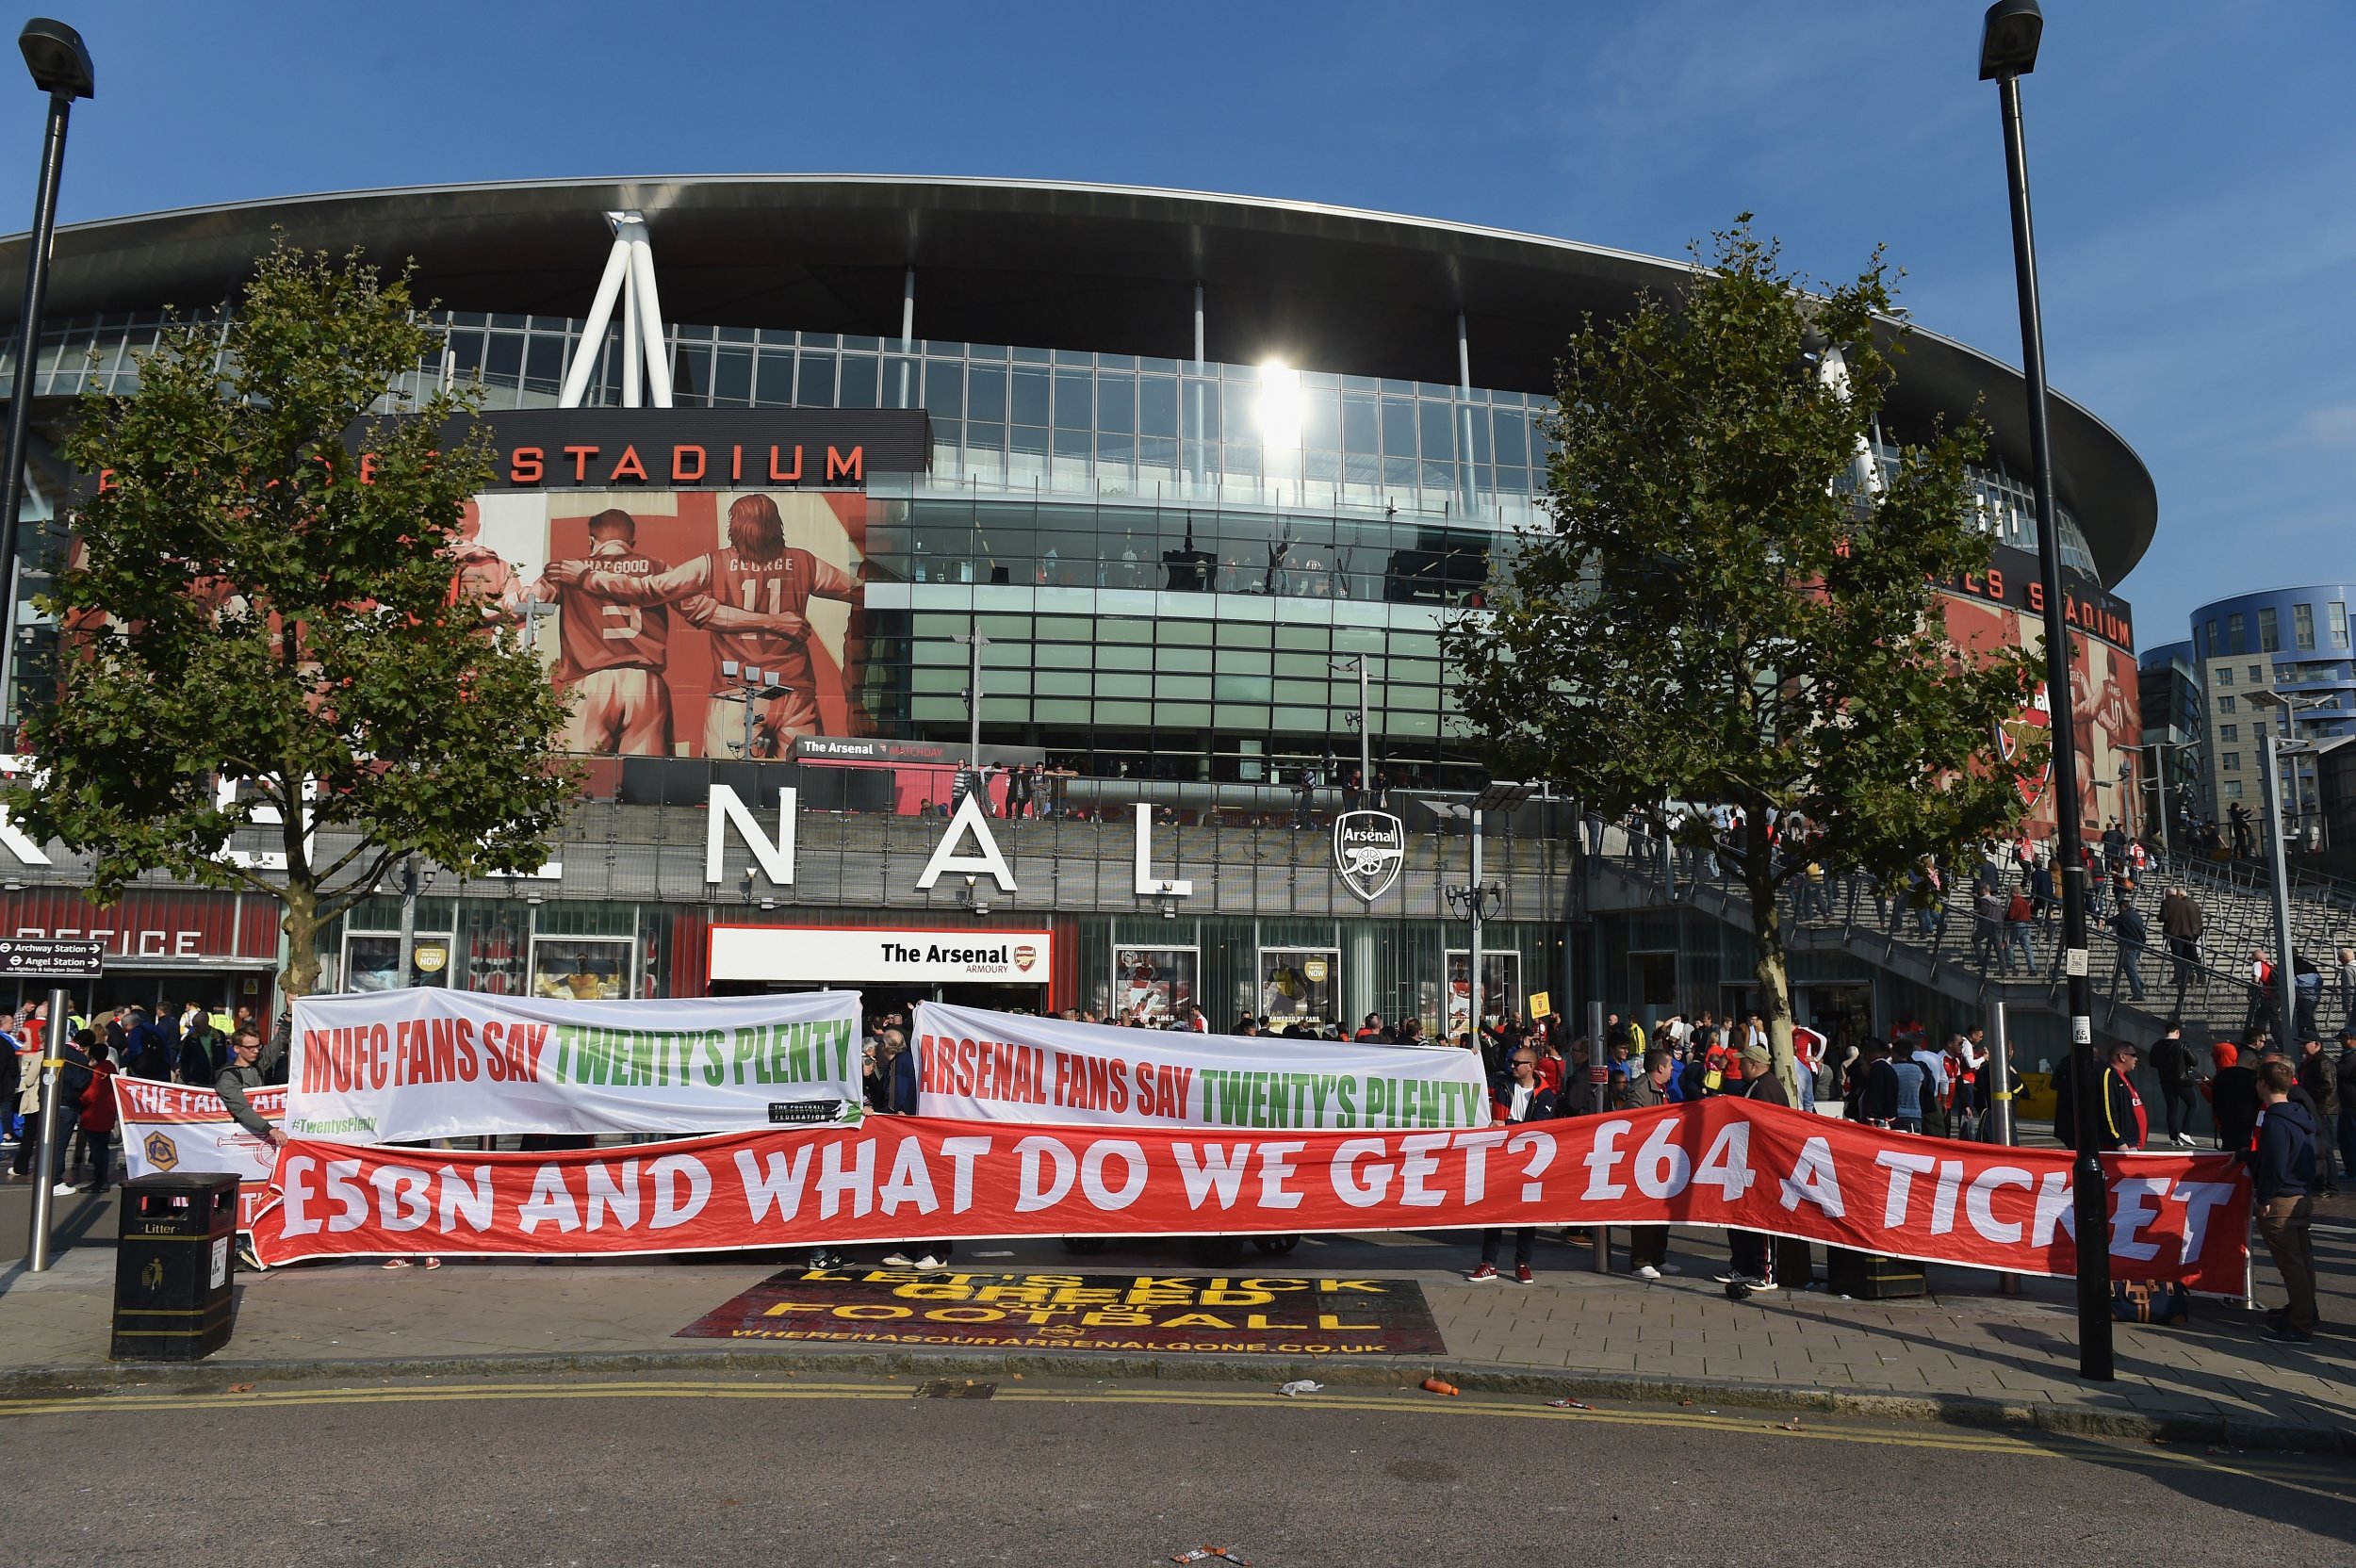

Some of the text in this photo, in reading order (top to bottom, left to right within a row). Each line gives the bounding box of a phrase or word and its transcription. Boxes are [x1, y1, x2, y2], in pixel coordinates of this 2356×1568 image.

[510, 444, 862, 484] STADIUM
[2029, 581, 2131, 647] SADIUM
[804, 741, 943, 759] The Arsenal MATCHDAY
[1344, 827, 1396, 842] Arsenal
[14, 943, 87, 955] Archway Station
[881, 943, 1008, 964] The Arsenal
[25, 956, 86, 967] Angel Station
[419, 956, 442, 966] NOW
[965, 964, 1008, 973] ARMOURY
[301, 1018, 853, 1093] MUFC FANS SAY TWENTY'S PLENTY
[919, 1034, 1481, 1129] ARSENAL FANS SAY TWENTY'S PLENTY
[125, 1085, 173, 1114] THE
[180, 1090, 228, 1114] FAN
[291, 1116, 378, 1135] #TwentysPlenty
[279, 1118, 2235, 1266] £5BN AND WHAT DO WE GET? £64 A TICKET
[145, 1223, 176, 1234] Litter
[799, 1271, 1390, 1293] LET'S KICK
[892, 1282, 1276, 1306] GREED
[762, 1302, 1382, 1330] FOOTBALL
[994, 1302, 1162, 1313] OUT OF
[731, 1330, 1389, 1353] WHEREHASOURARSENALGONE.CO.UK
